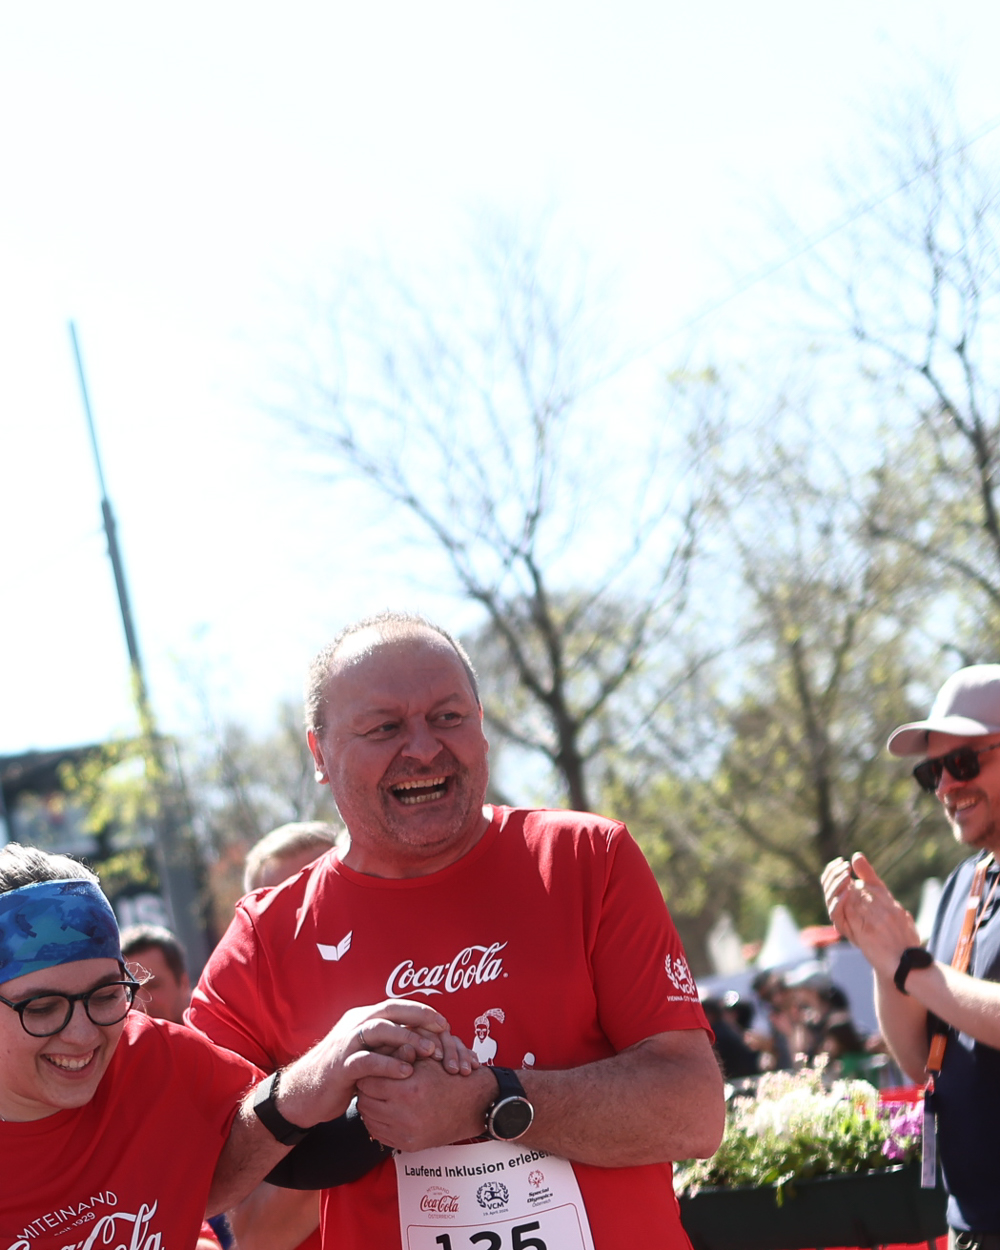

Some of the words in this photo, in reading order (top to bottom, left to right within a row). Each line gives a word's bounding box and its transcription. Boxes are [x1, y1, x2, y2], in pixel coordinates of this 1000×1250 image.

[385, 941, 509, 999] Coca-Cola
[404, 1165, 442, 1178] Laufend
[444, 1162, 505, 1177] Inklusion
[420, 1195, 460, 1212] Coca-Cola
[487, 1202, 504, 1210] VCM
[17, 1191, 118, 1240] MITEINAND
[72, 1212, 96, 1228] 1929
